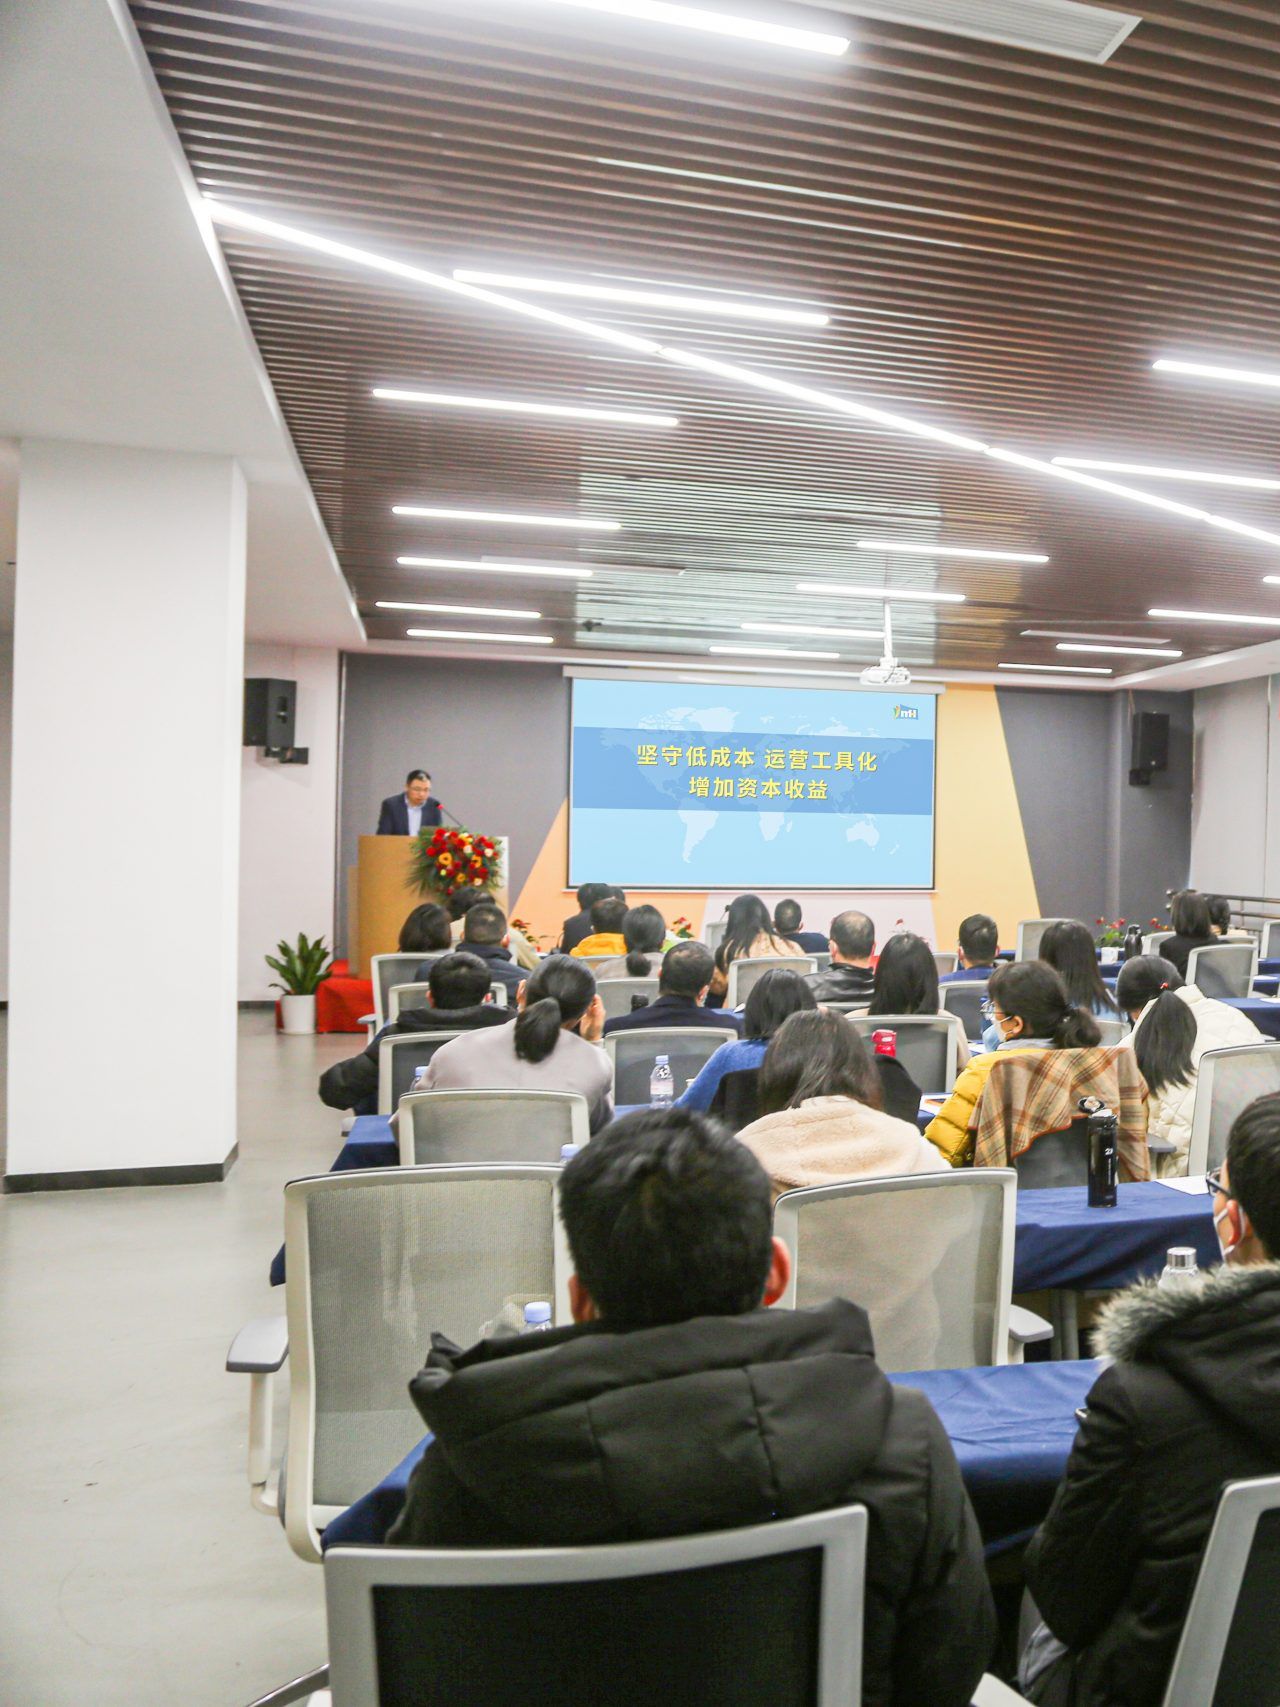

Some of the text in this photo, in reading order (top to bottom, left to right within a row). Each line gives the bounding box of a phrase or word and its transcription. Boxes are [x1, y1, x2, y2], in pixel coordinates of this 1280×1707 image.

[636, 744, 878, 772] 坚守低成本 运营工具化
[688, 776, 829, 800] 增加资本收益
